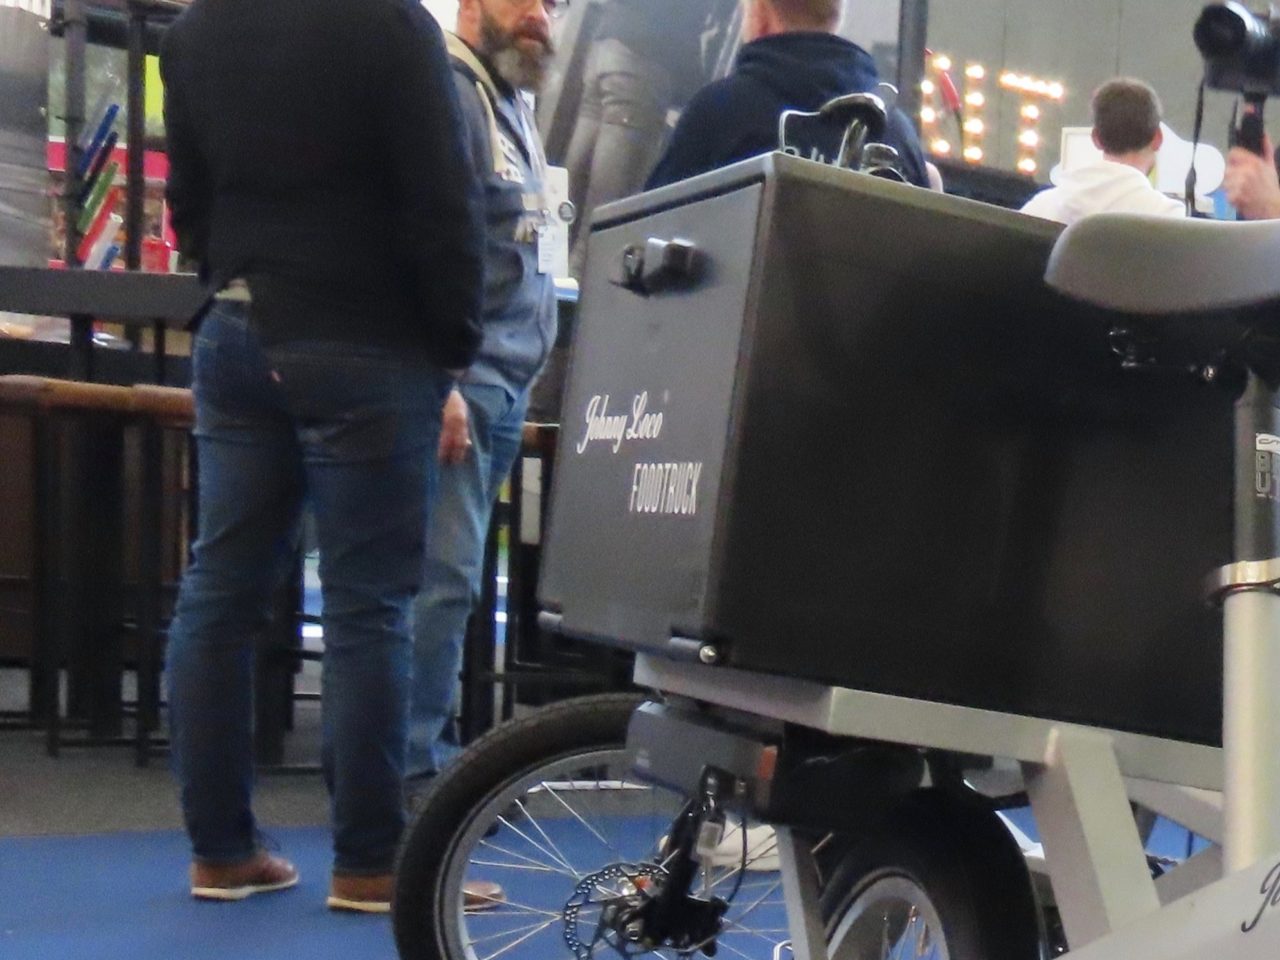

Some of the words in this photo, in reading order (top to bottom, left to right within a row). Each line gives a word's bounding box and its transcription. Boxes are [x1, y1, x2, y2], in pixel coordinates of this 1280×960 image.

[576, 394, 628, 454] Johnny
[626, 391, 663, 440] Loco
[629, 461, 702, 514] FOODTRUCK
